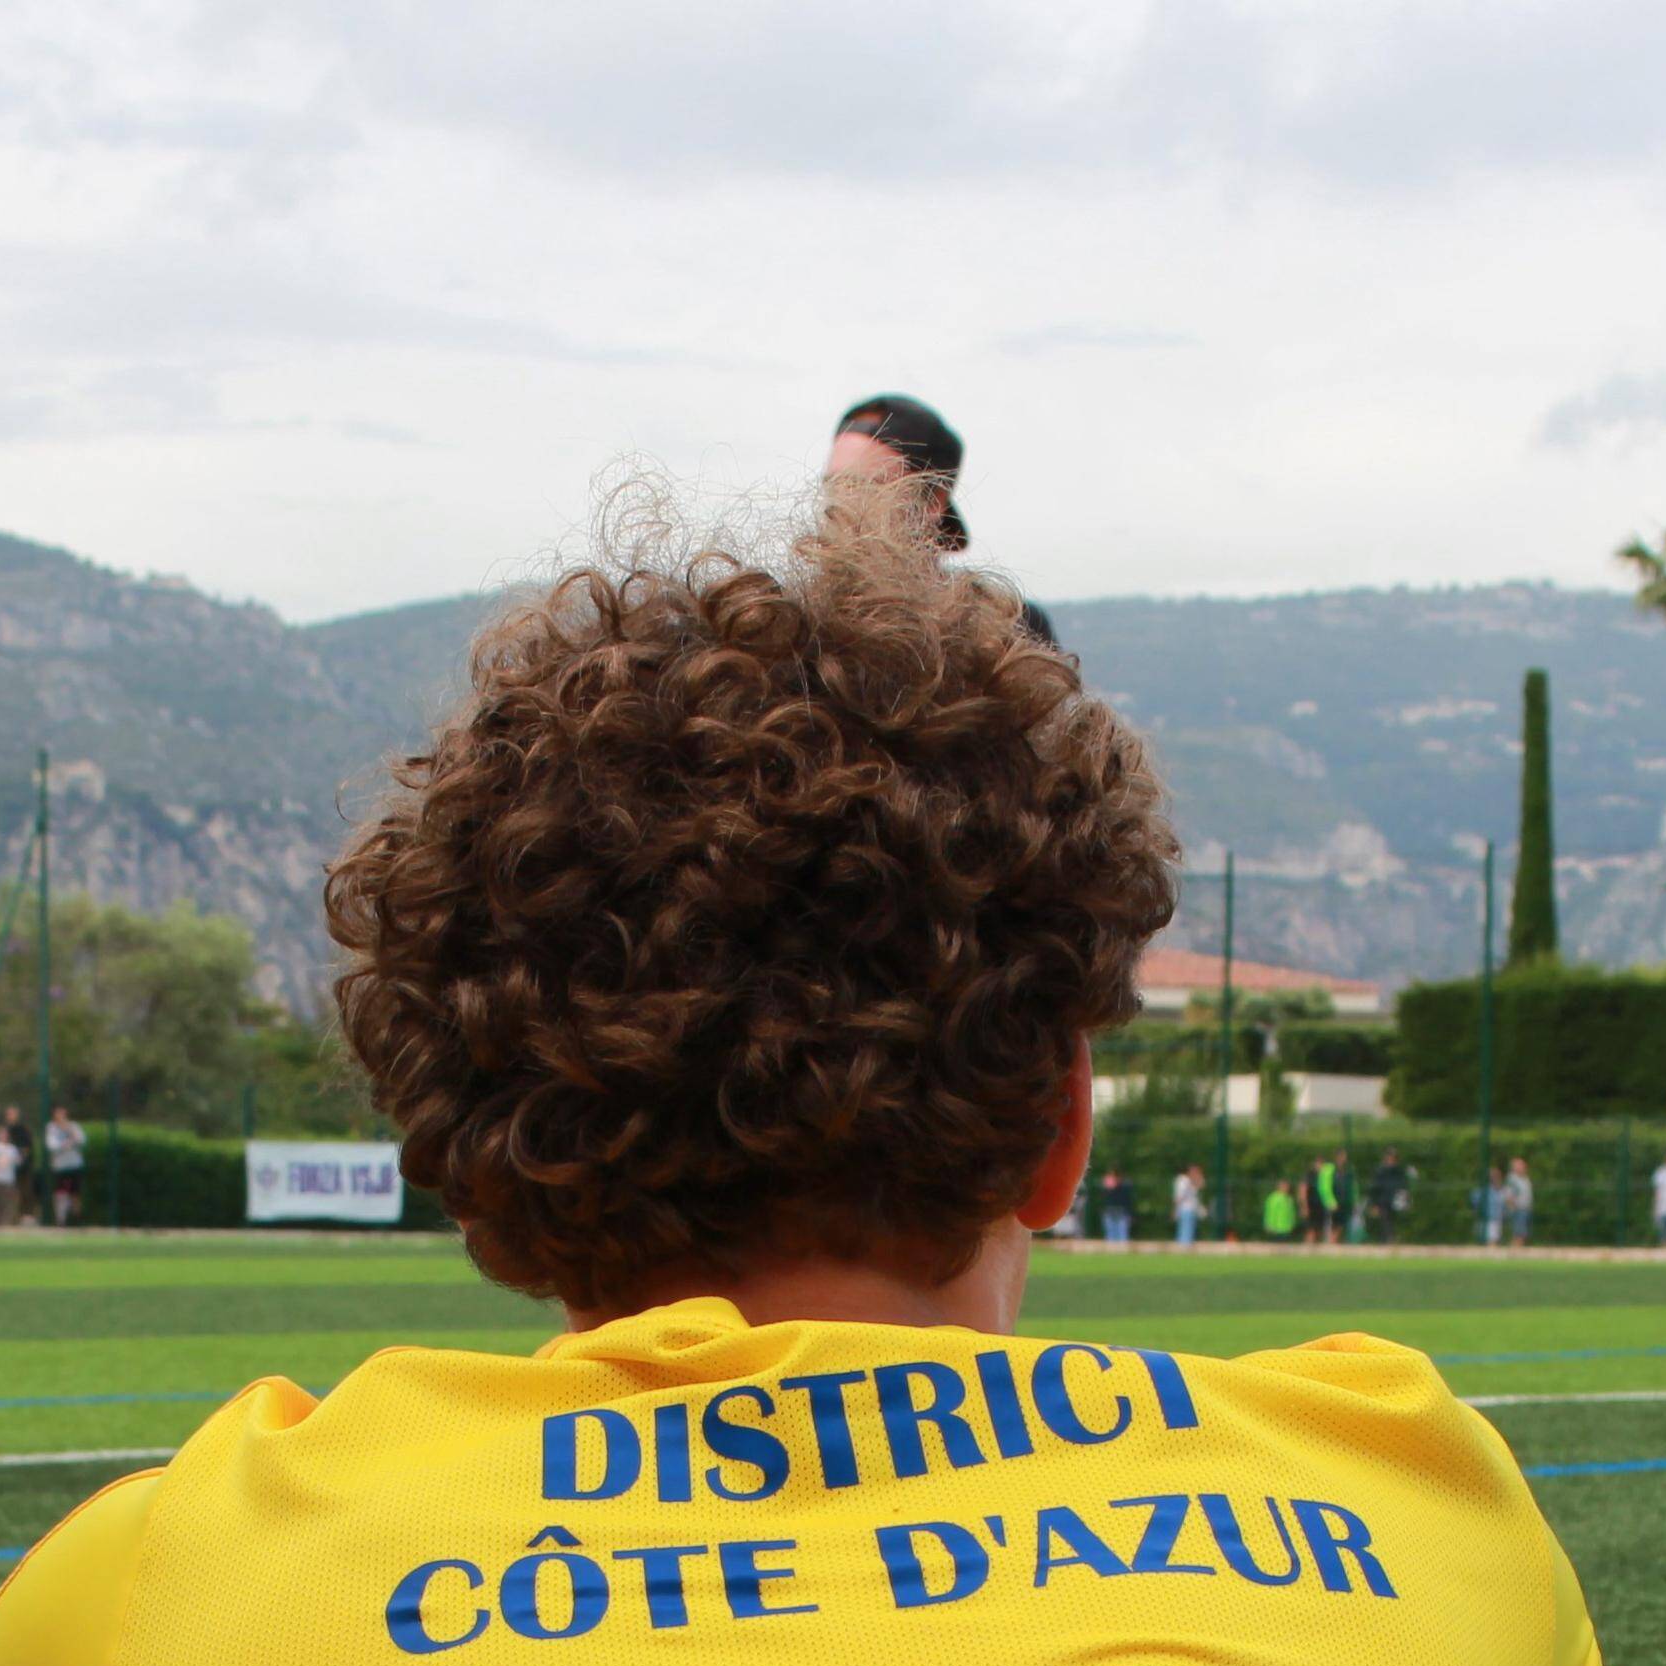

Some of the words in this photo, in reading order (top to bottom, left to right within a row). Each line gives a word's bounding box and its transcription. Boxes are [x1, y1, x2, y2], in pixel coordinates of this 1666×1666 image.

[542, 1344, 1199, 1501] DISTRICT
[384, 1523, 820, 1654] CÔTE
[876, 1493, 1398, 1609] D'AZUR
